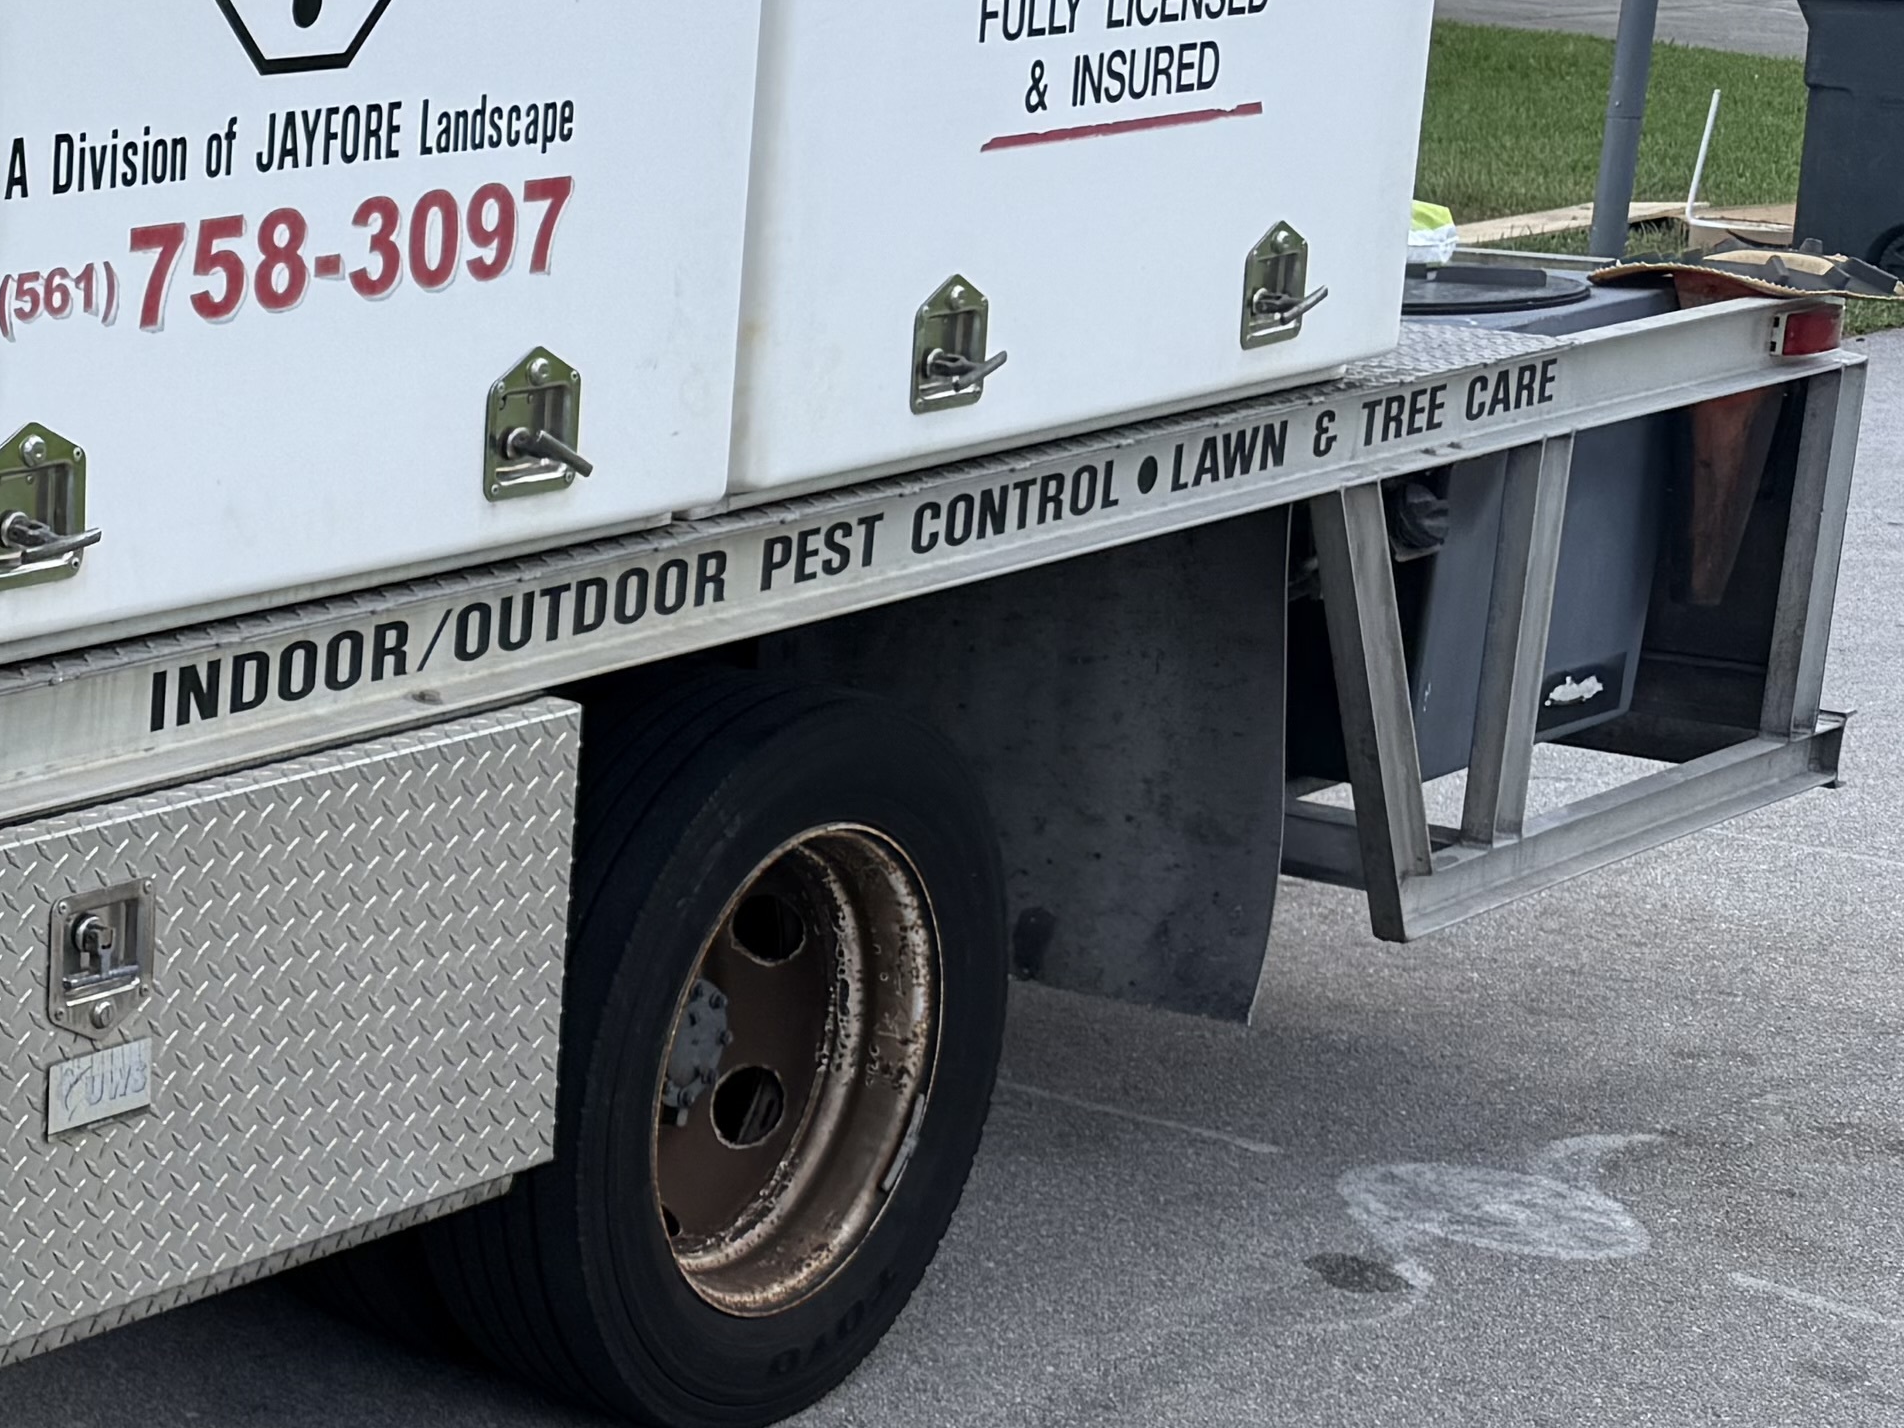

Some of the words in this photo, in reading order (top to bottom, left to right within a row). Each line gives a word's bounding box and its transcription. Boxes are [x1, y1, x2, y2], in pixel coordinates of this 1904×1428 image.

[1024, 58, 1049, 113] &
[1072, 40, 1220, 107] INSURED
[3, 137, 29, 201] A
[52, 125, 187, 196] Division
[206, 117, 238, 179] of
[256, 100, 402, 174] JAYFORE
[420, 93, 574, 156] Landscape
[129, 175, 576, 333] 758-3097
[149, 549, 728, 733] INDOOR/OUTDOOR
[760, 512, 886, 591] PEST
[910, 458, 1120, 555] CONTROL
[1170, 419, 1288, 494] LAWN
[1313, 409, 1338, 458] &
[1361, 383, 1448, 447] TREE
[1465, 357, 1558, 422] CARE
